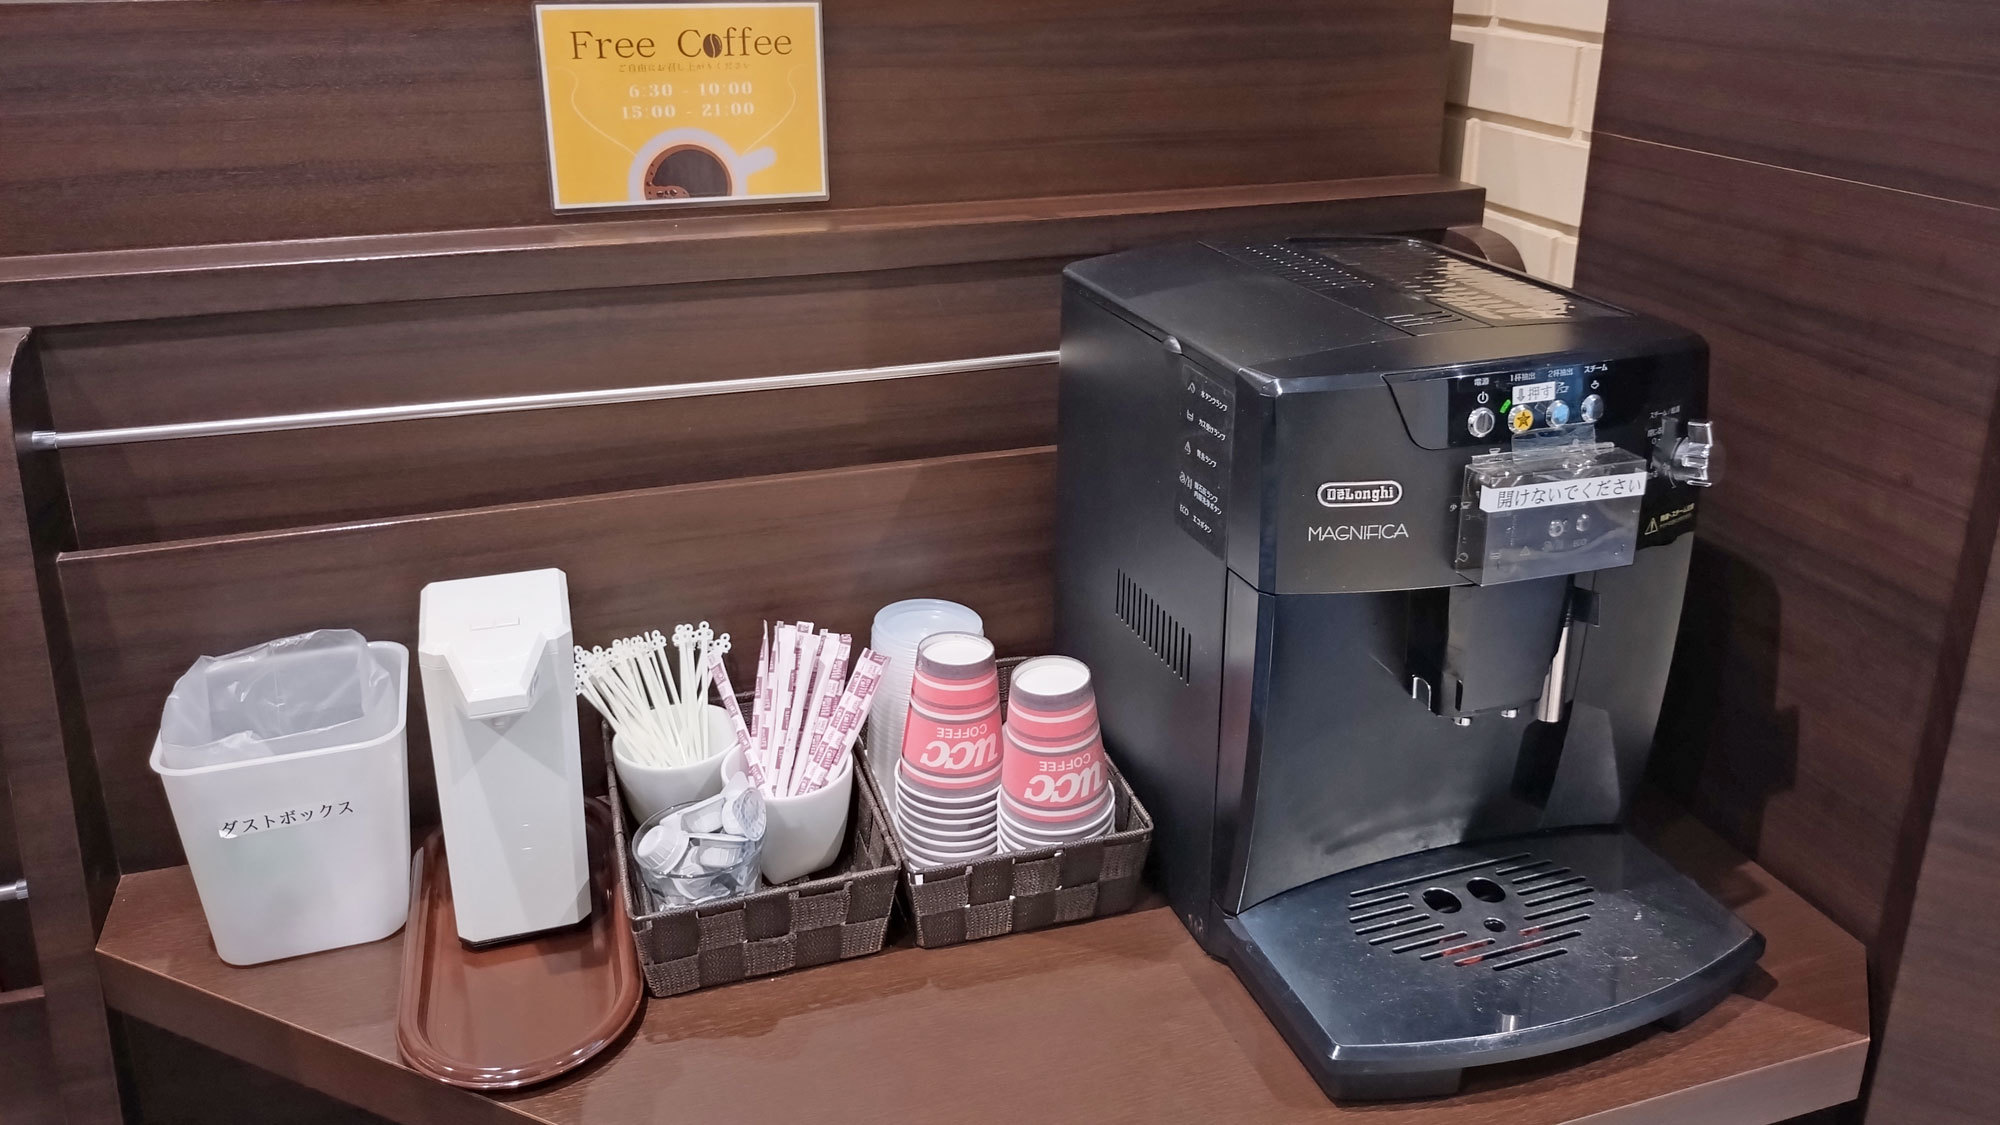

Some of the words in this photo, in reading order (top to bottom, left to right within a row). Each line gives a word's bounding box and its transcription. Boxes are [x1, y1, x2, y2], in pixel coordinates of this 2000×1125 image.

[570, 30, 656, 60] Free
[629, 84, 673, 98] 6:30
[699, 81, 753, 97] 10:00
[622, 104, 676, 120] 15:00
[702, 102, 755, 117] 21:00
[1584, 363, 1608, 374] スチーム
[1528, 386, 1553, 401] 押す
[1497, 478, 1641, 509] 開けないでください
[1308, 523, 1409, 541] MAGNIFICA
[936, 722, 988, 739] COFFEE
[920, 733, 998, 770] UCC
[1039, 753, 1091, 772] COFFEE
[1024, 760, 1103, 803] UCC
[222, 801, 354, 837] ダストボックス
